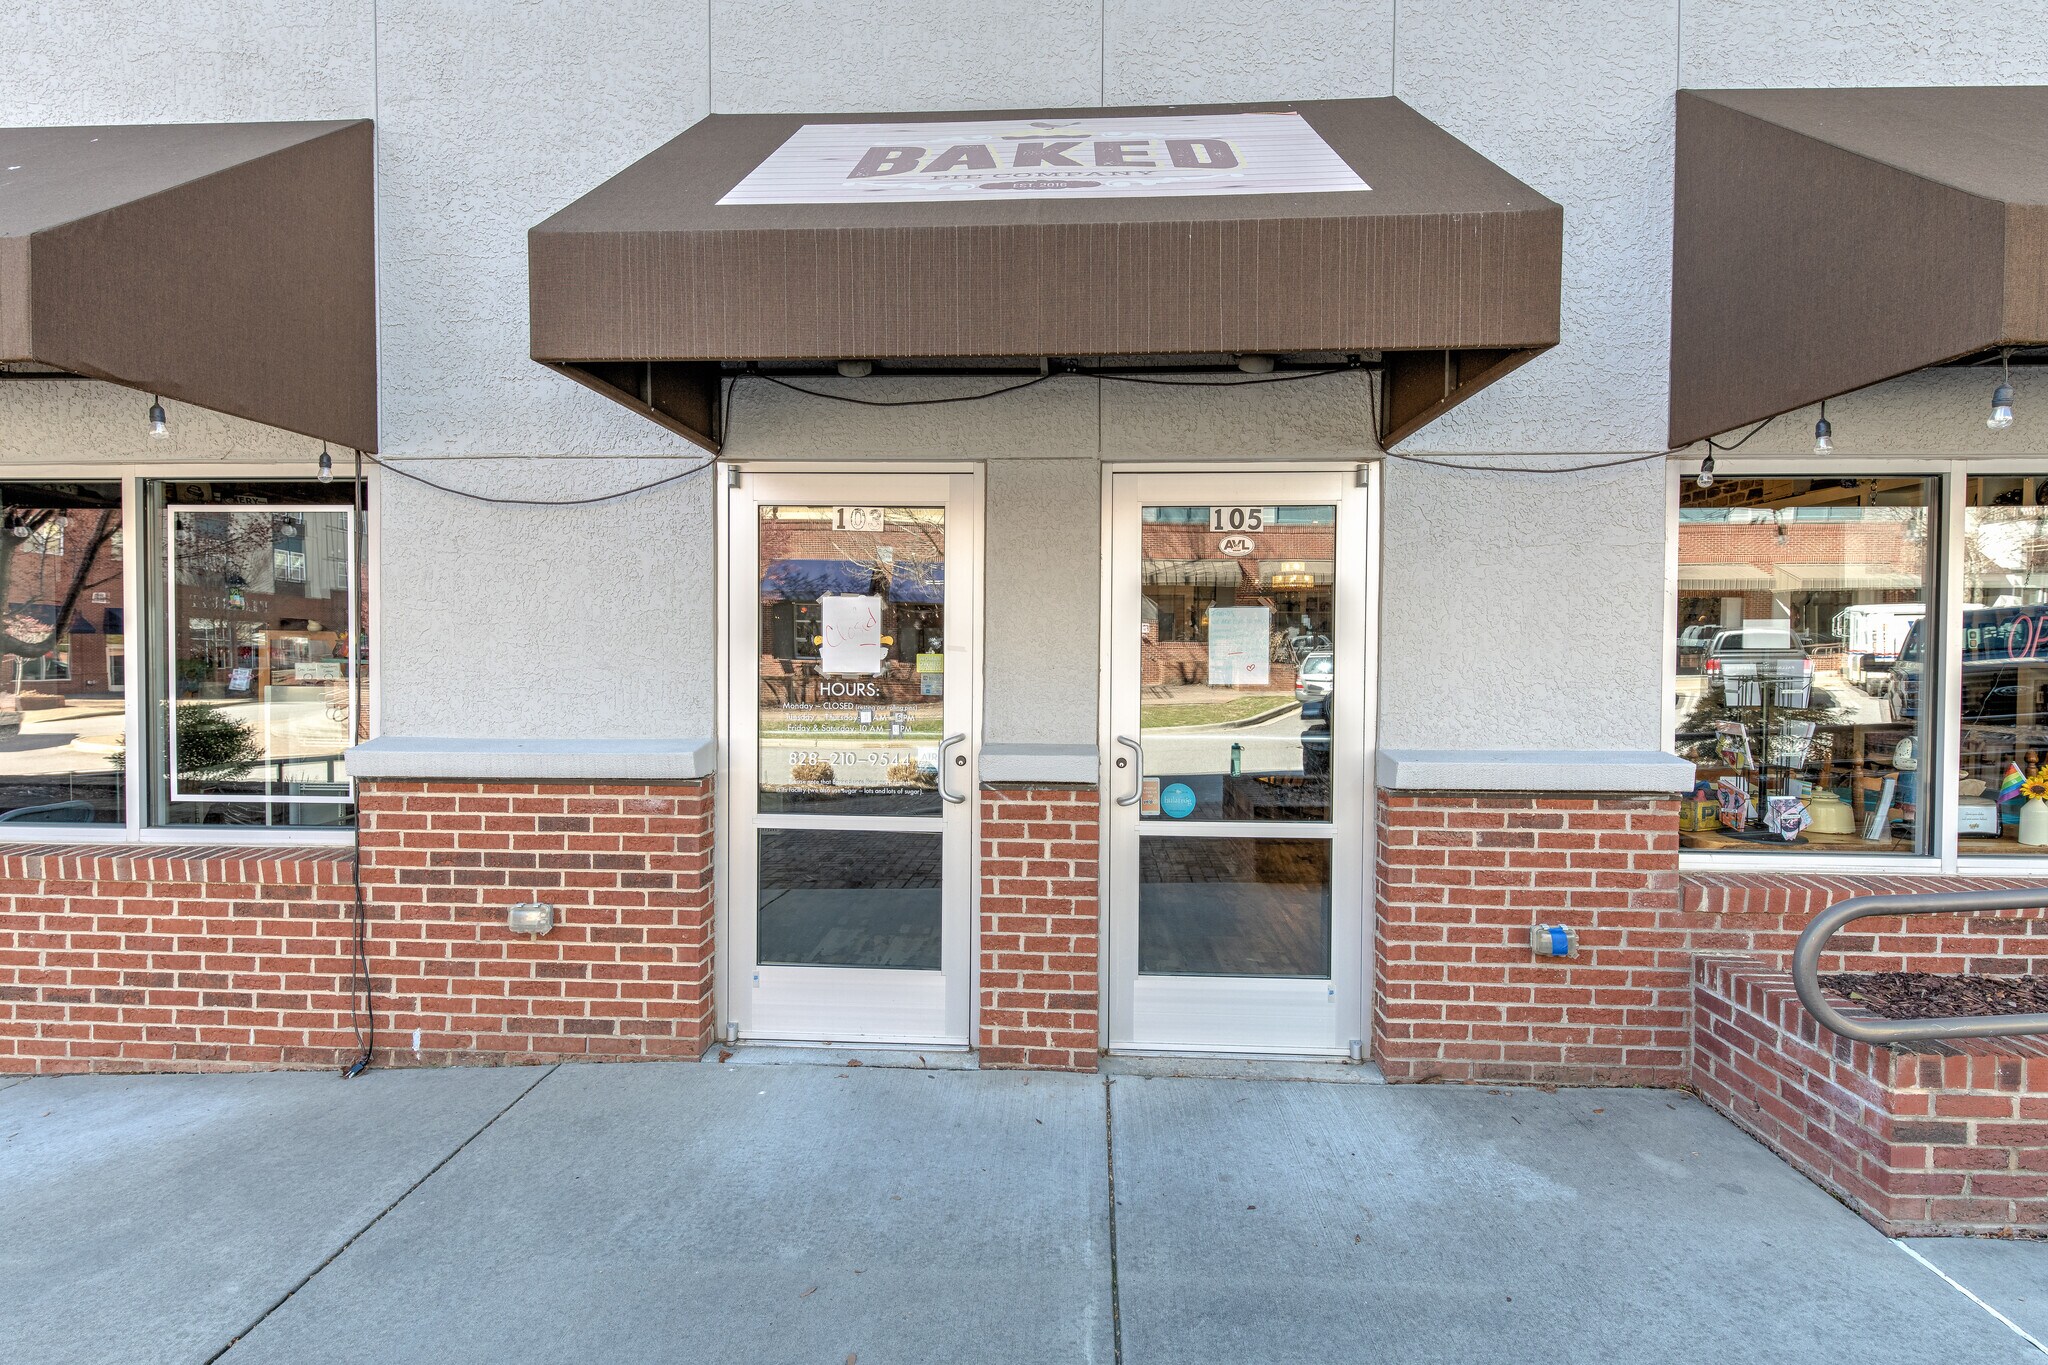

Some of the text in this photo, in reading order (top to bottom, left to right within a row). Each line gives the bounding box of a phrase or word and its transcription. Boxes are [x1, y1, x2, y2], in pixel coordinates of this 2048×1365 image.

[846, 139, 1239, 179] BAKED
[836, 507, 882, 531] 103
[1214, 507, 1262, 531] 105
[820, 682, 880, 697] HOURS:
[782, 702, 814, 711] Monday
[823, 702, 854, 710] CLOSED
[787, 724, 810, 732] Friday
[812, 724, 819, 732] &
[859, 724, 868, 732] 10
[904, 788, 924, 796] sugar).
